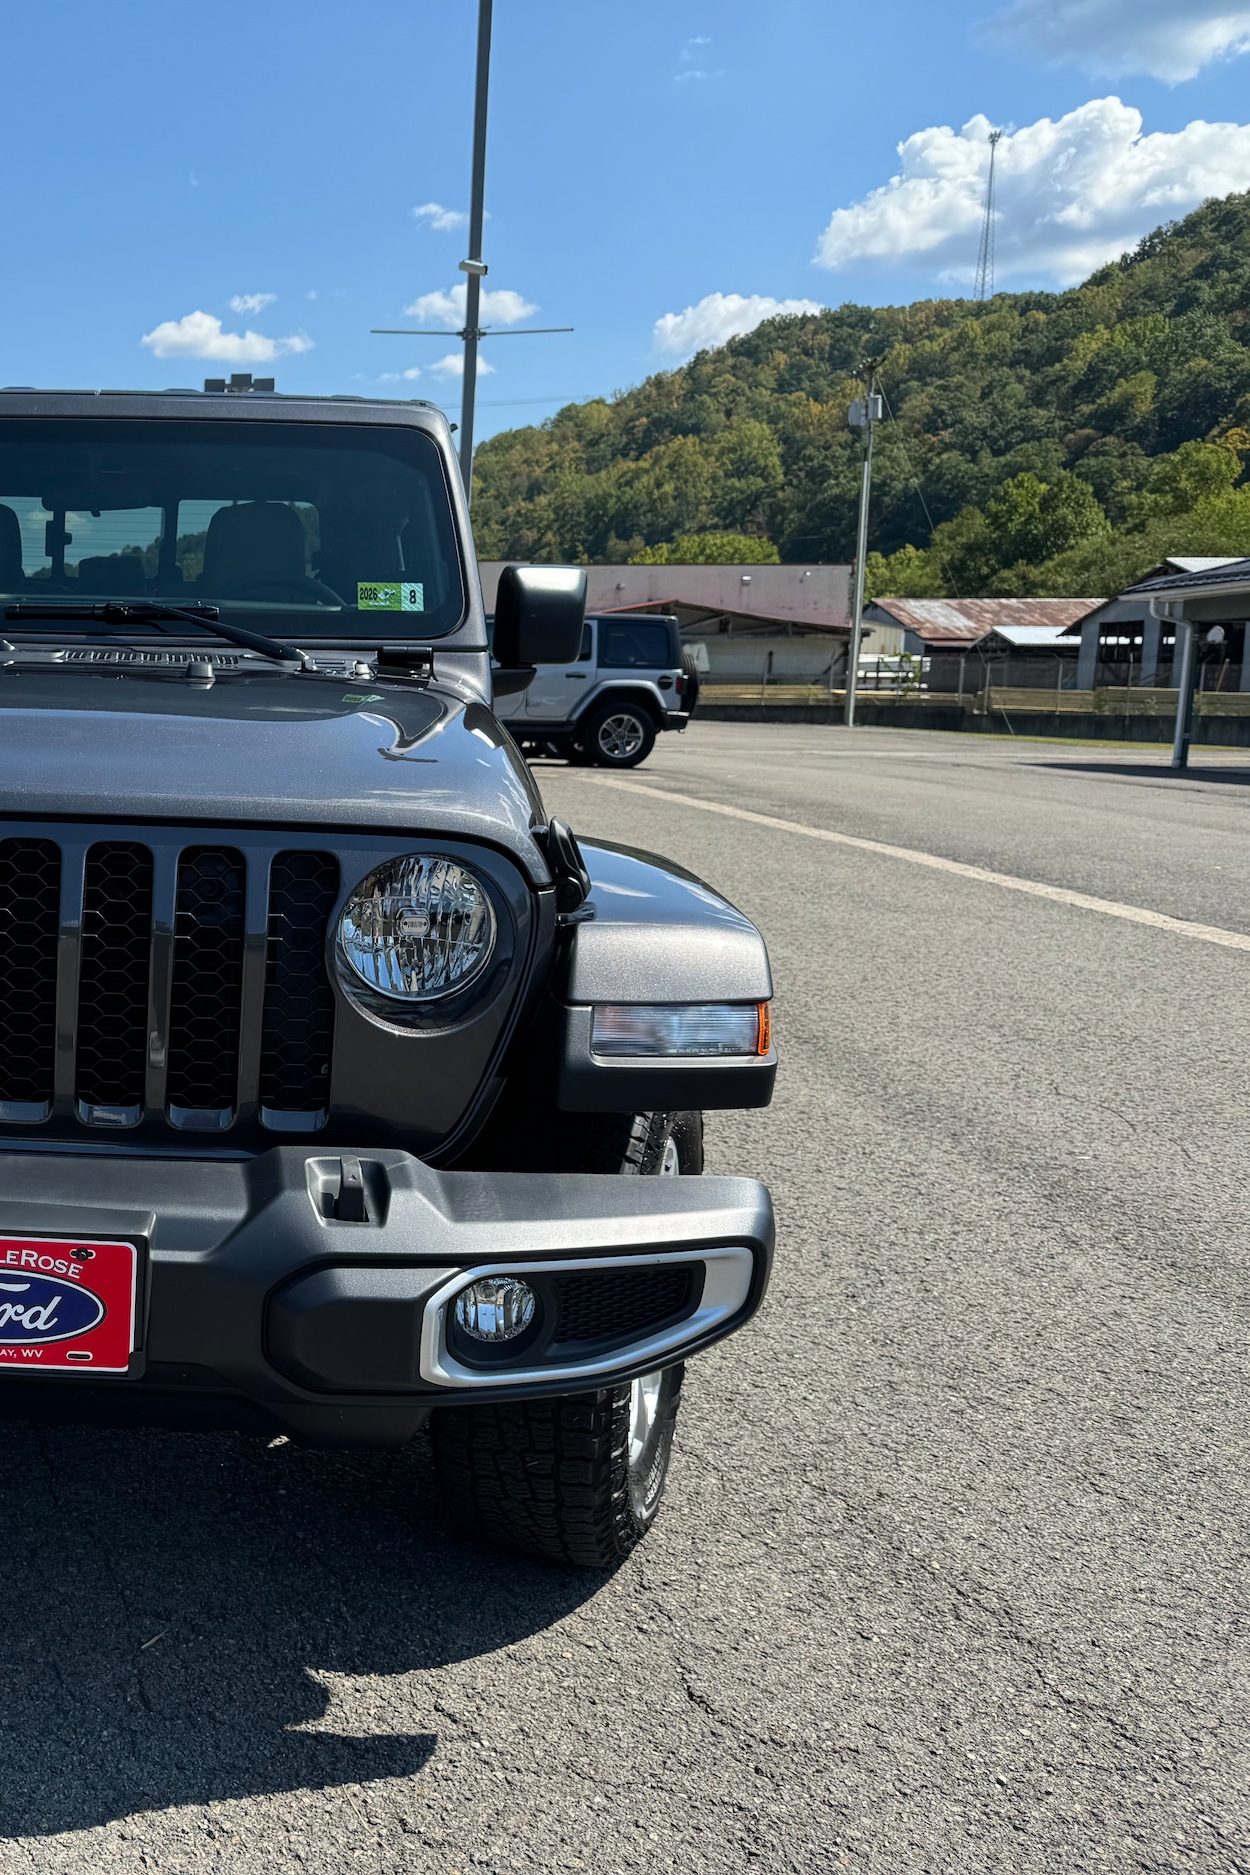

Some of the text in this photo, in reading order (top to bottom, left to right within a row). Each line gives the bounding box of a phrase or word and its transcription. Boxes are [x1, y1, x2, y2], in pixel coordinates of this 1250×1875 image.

[359, 587, 378, 601] 2026
[409, 589, 417, 604] 8
[22, 1348, 44, 1358] WV
